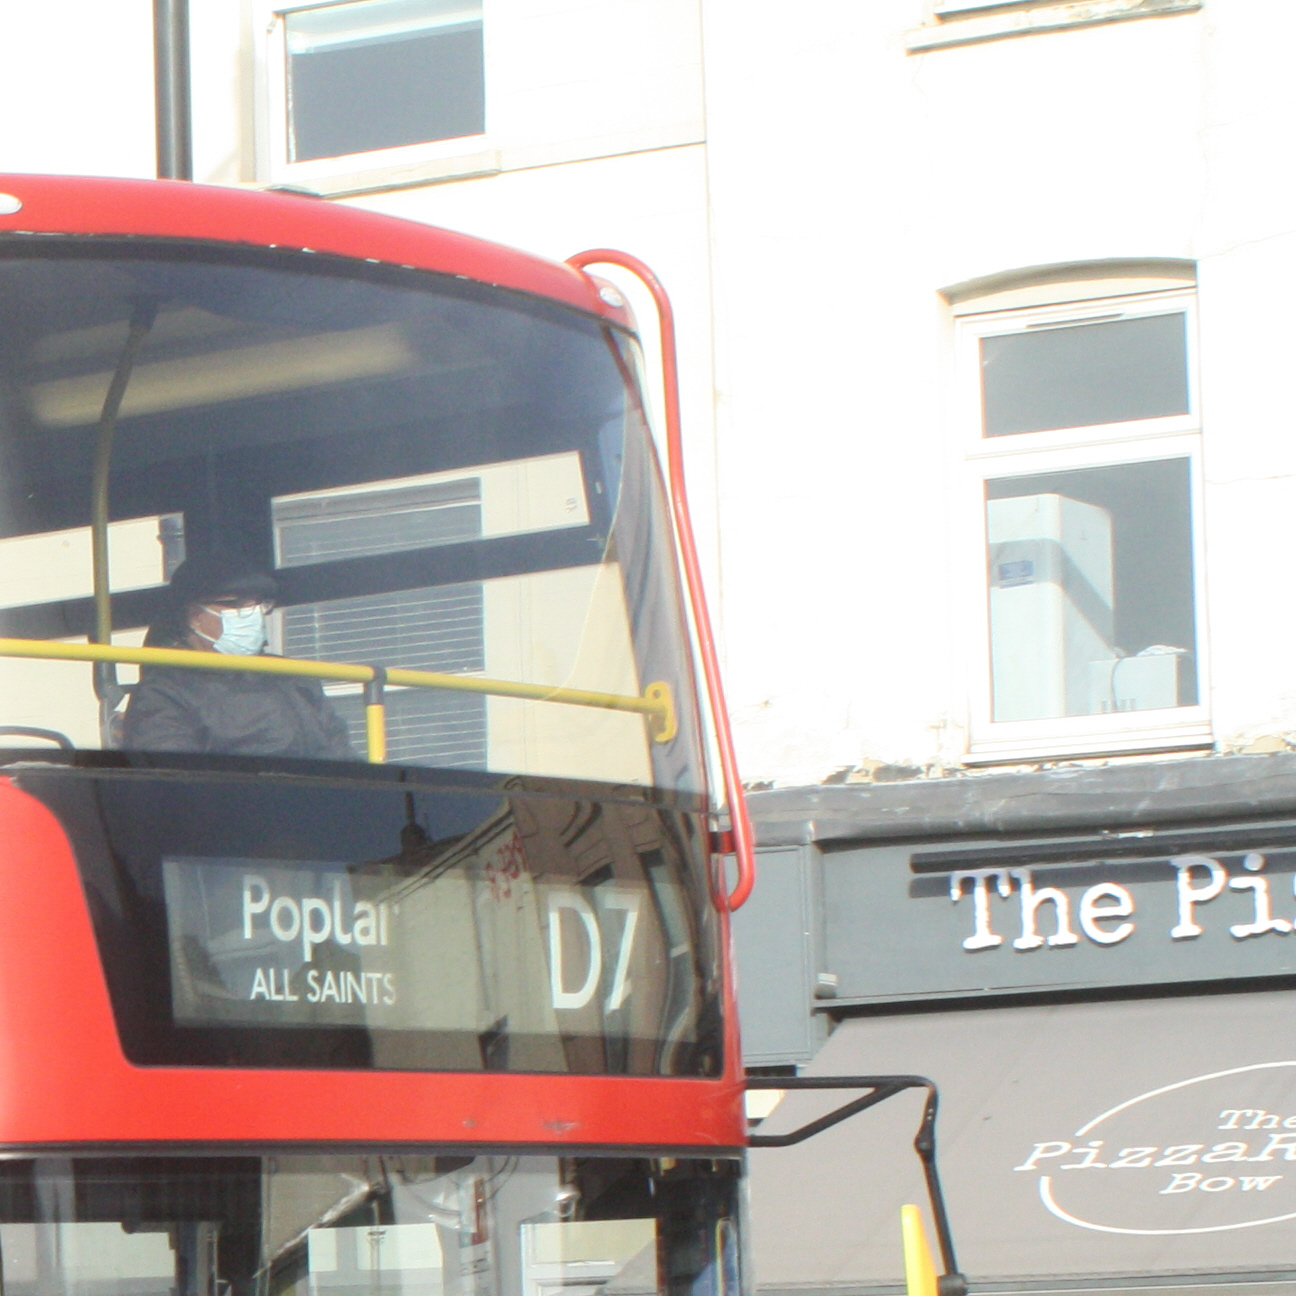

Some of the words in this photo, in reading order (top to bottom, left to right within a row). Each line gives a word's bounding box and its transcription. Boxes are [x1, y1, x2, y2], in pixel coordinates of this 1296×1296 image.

[950, 867, 1135, 950] The
[242, 874, 401, 962] Poplar
[548, 890, 642, 1010] D7
[250, 967, 299, 1001] ALL
[307, 969, 397, 1005] SAINTS
[1217, 1109, 1296, 1130] The
[1159, 1172, 1284, 1195] Bow
